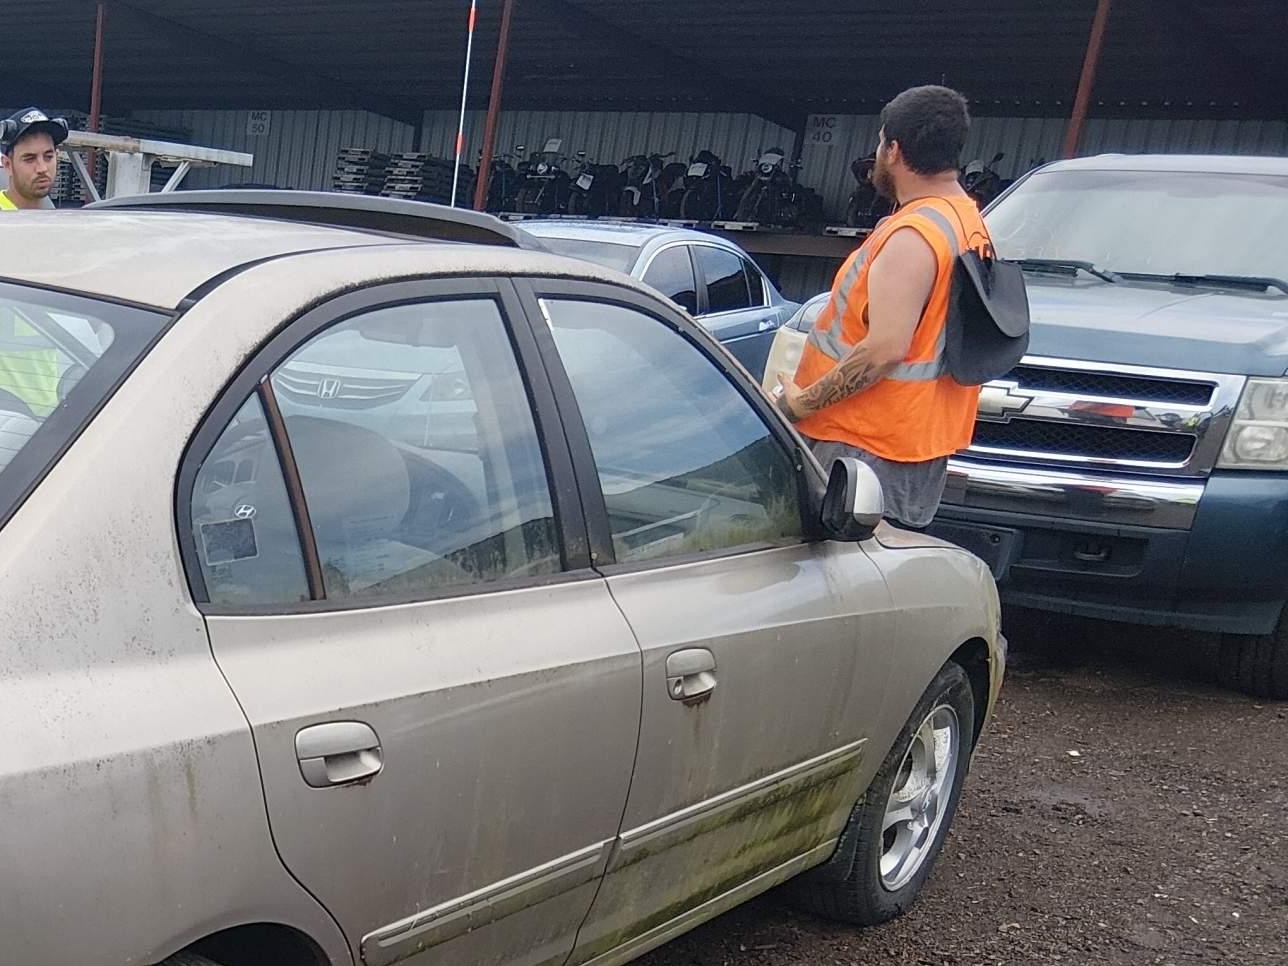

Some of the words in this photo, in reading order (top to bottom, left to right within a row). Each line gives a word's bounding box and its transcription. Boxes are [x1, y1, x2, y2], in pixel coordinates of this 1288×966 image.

[251, 111, 267, 121] MC
[813, 116, 836, 128] MC
[812, 131, 832, 142] 40
